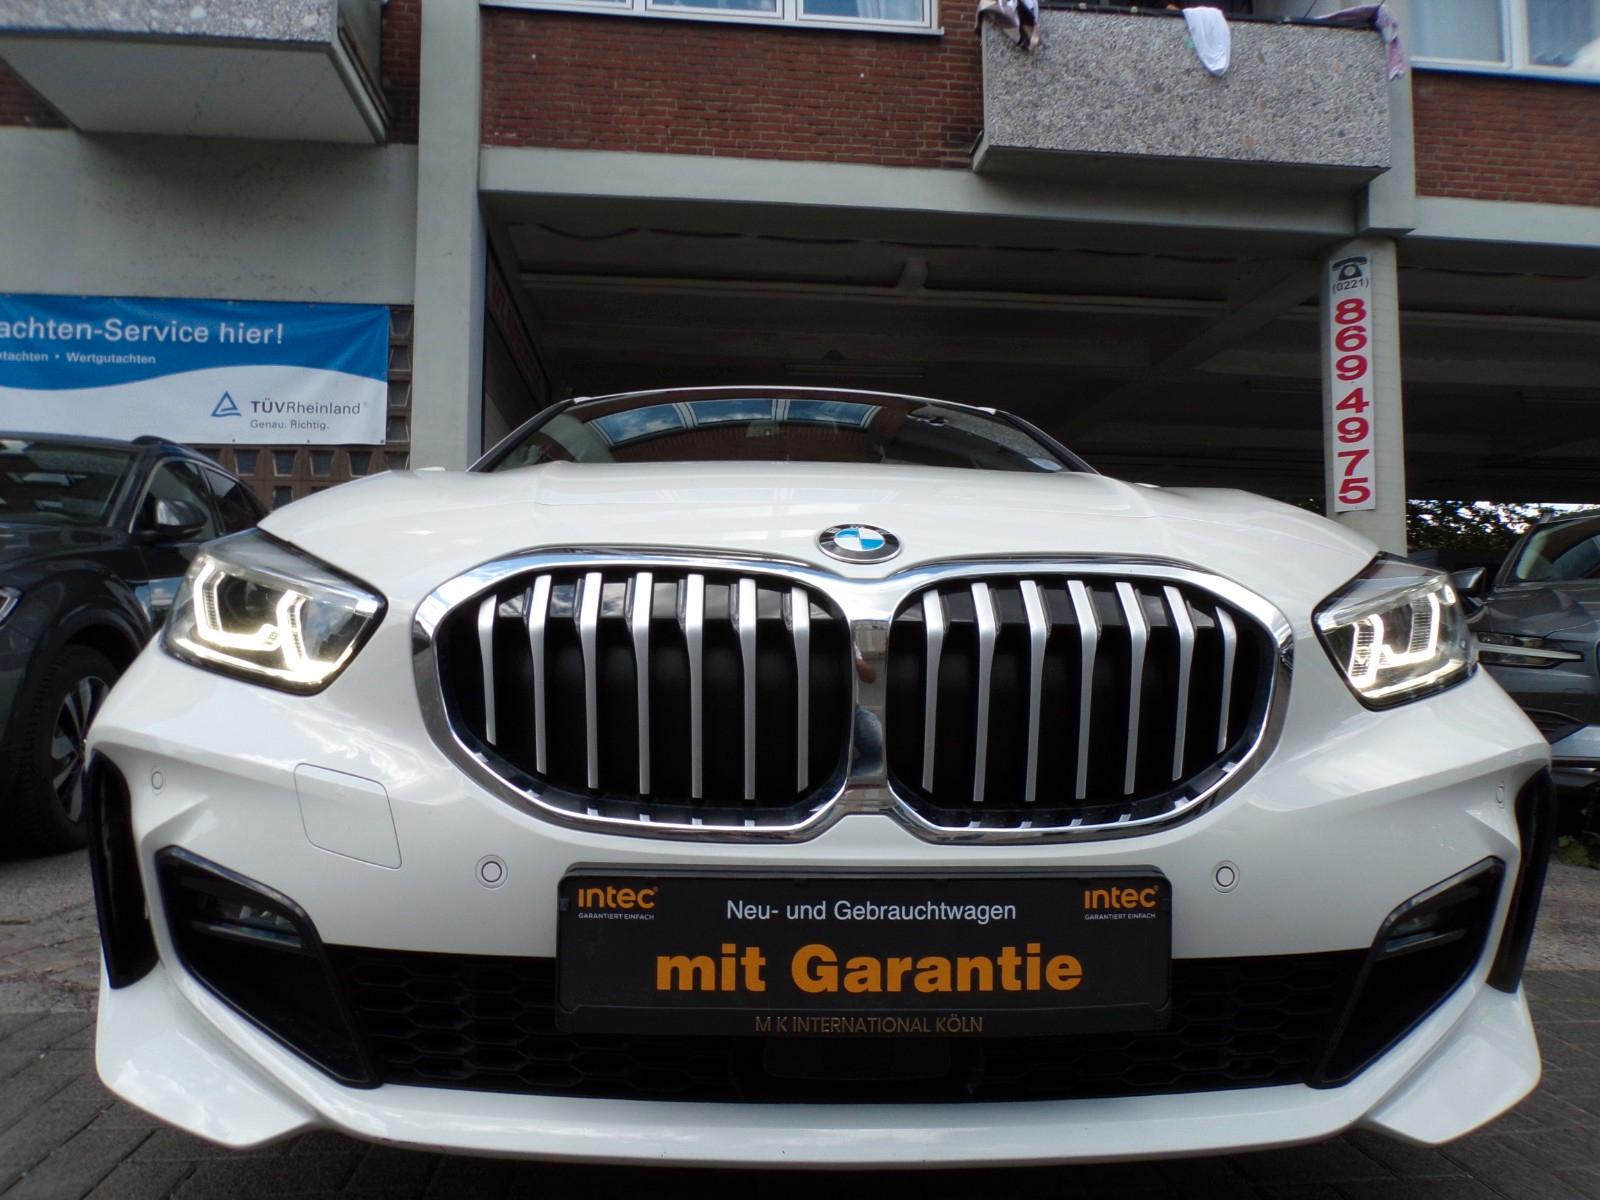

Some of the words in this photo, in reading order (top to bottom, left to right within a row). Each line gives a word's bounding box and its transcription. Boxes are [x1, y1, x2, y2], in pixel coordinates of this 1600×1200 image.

[1332, 277, 1369, 294] (0221)
[219, 322, 283, 344] hier!
[66, 352, 156, 365] Wertgutachten
[250, 419, 288, 429] Genau.
[290, 420, 329, 431] Richtig.
[578, 886, 656, 909] intec
[1084, 886, 1157, 909] intec
[578, 912, 622, 920] GARANTIERT
[727, 900, 778, 920] Neu-
[787, 901, 826, 920] und
[834, 900, 1016, 924] Gebrauchtwagen
[1127, 912, 1156, 920] EINFACH
[656, 943, 766, 992] mit
[791, 943, 1083, 993] Garantie
[755, 1016, 772, 1032] M
[776, 1016, 788, 1032] K
[792, 1016, 930, 1033] INTERNATIONAL
[936, 1013, 983, 1033] KÖLN
